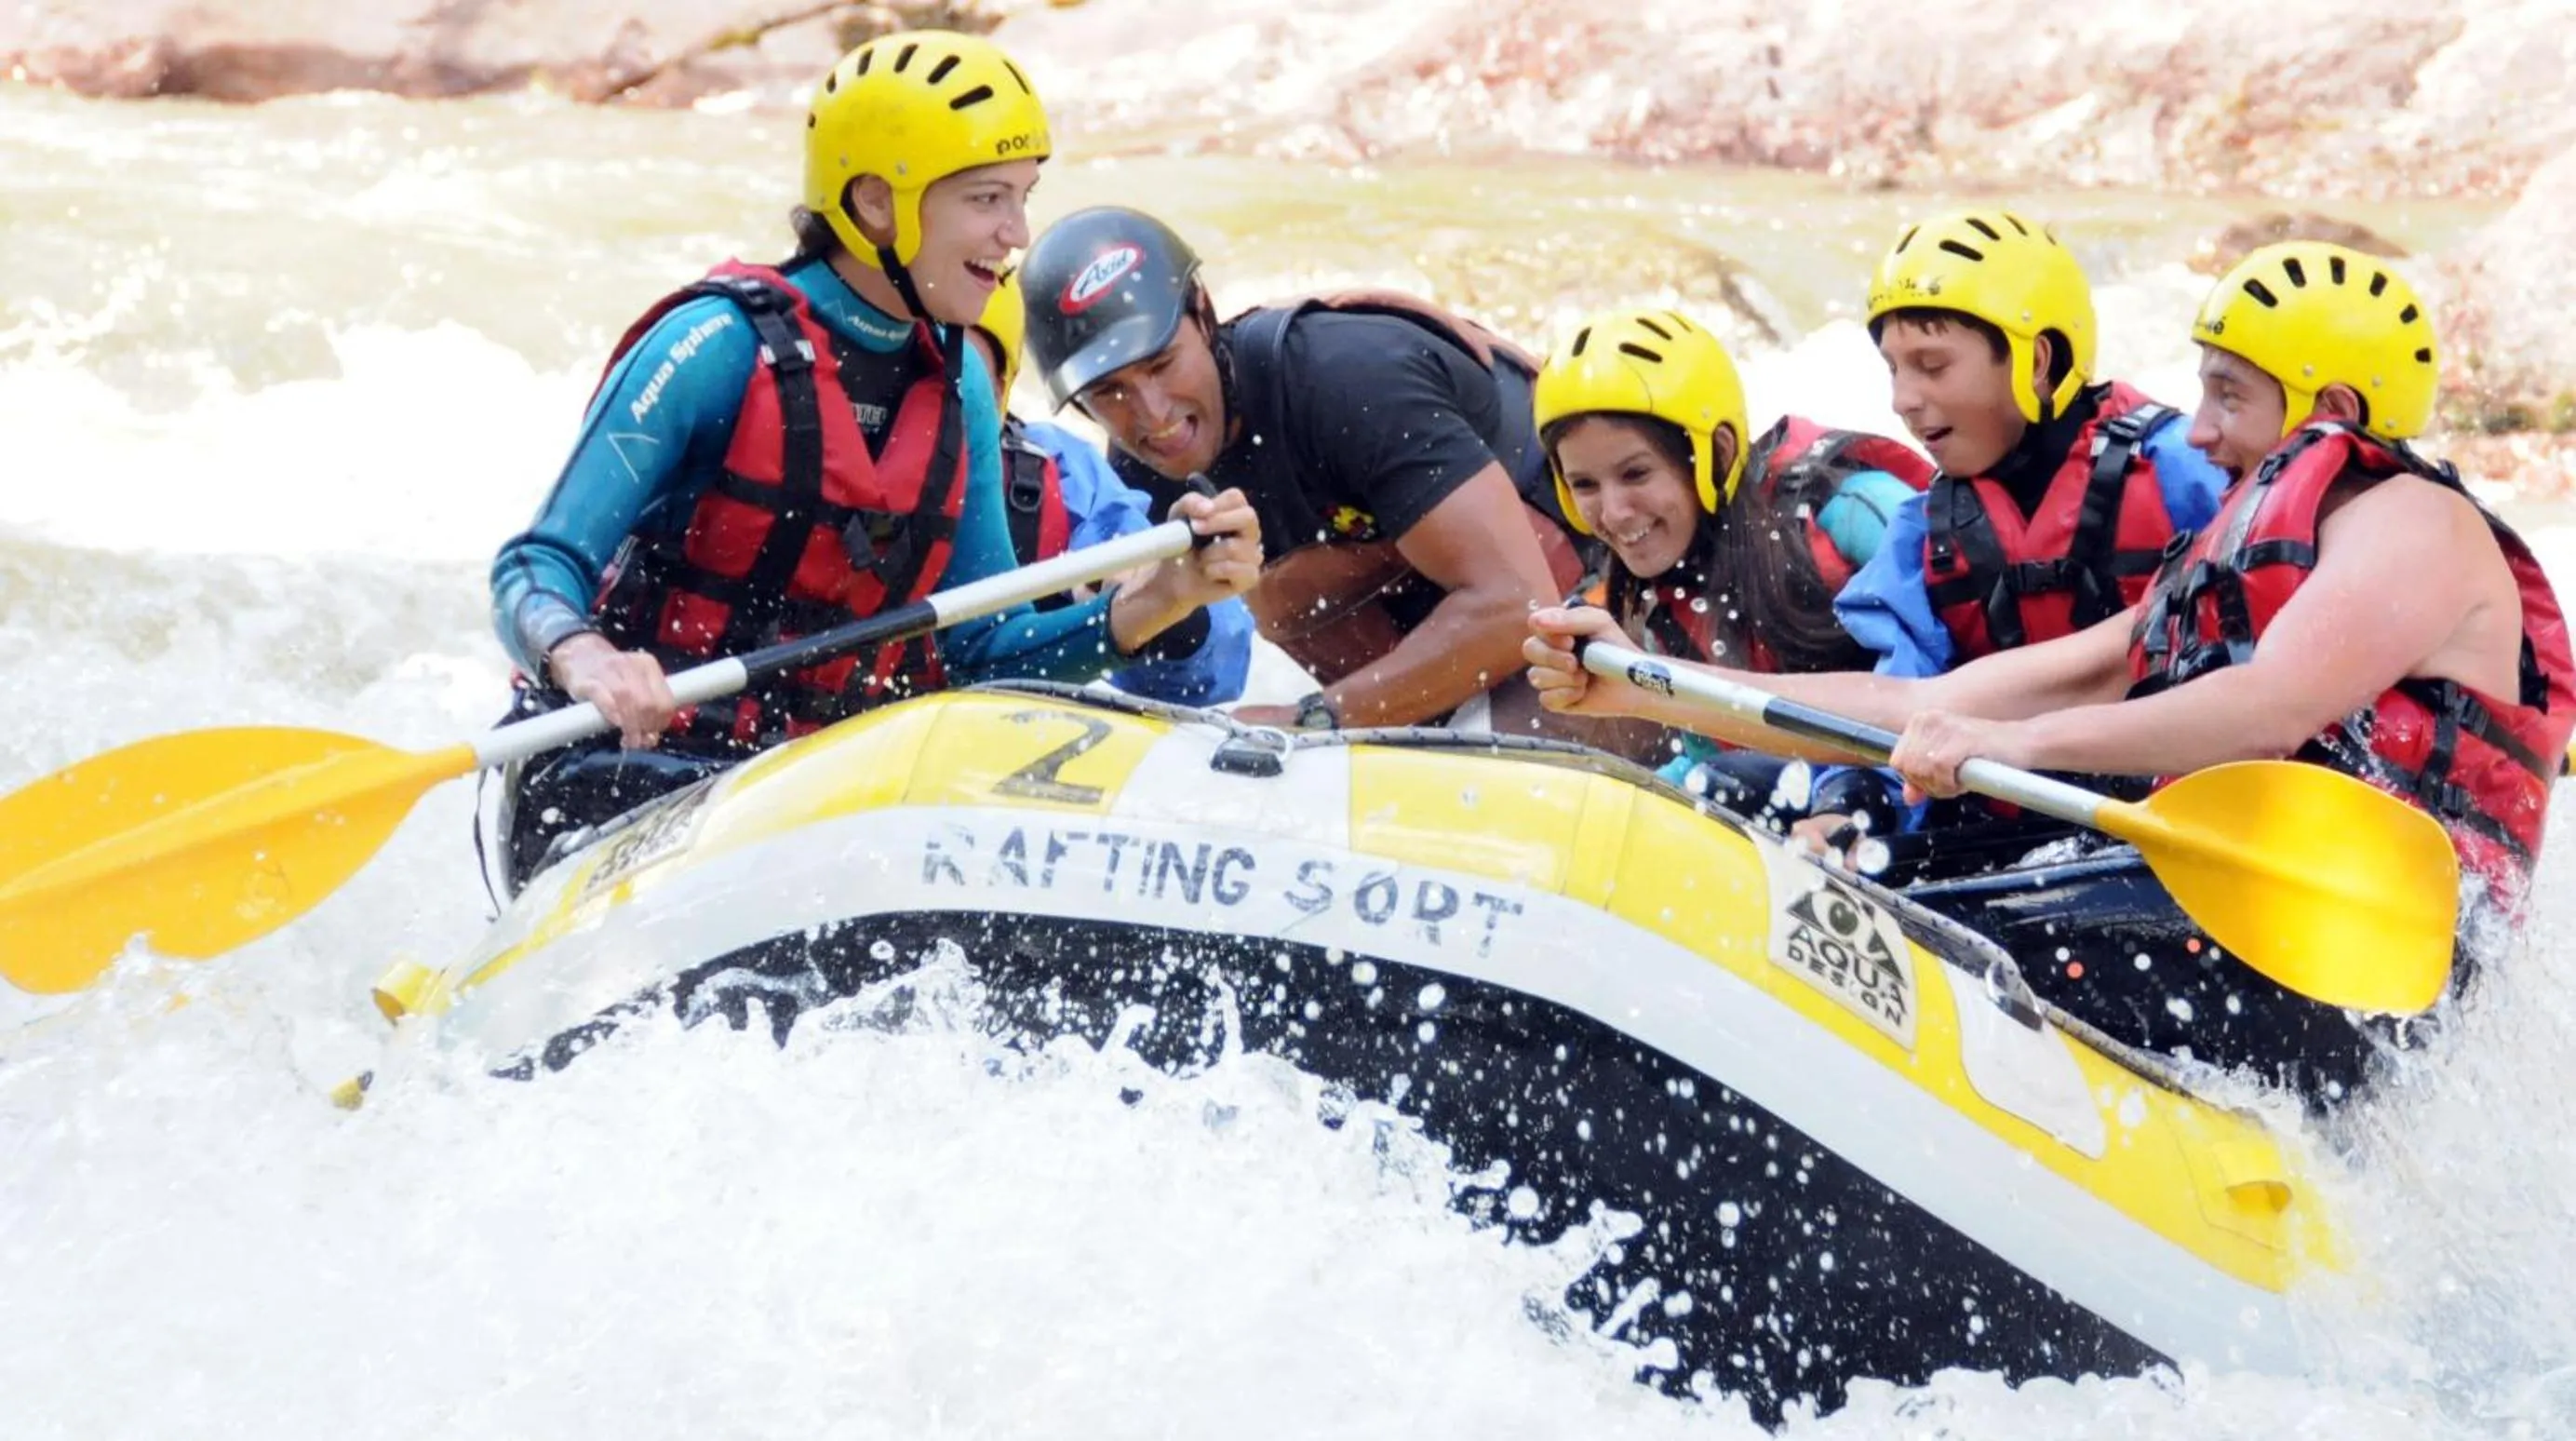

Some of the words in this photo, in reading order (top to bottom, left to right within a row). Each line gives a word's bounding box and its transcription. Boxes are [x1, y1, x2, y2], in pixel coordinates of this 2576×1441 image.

[630, 360, 676, 425] Aqua
[990, 710, 1112, 804] 2
[921, 823, 1256, 905] RAFTING
[1283, 859, 1523, 958] SORT
[1787, 943, 1901, 1027] DESGN
[1789, 925, 1907, 1015] AQUA
